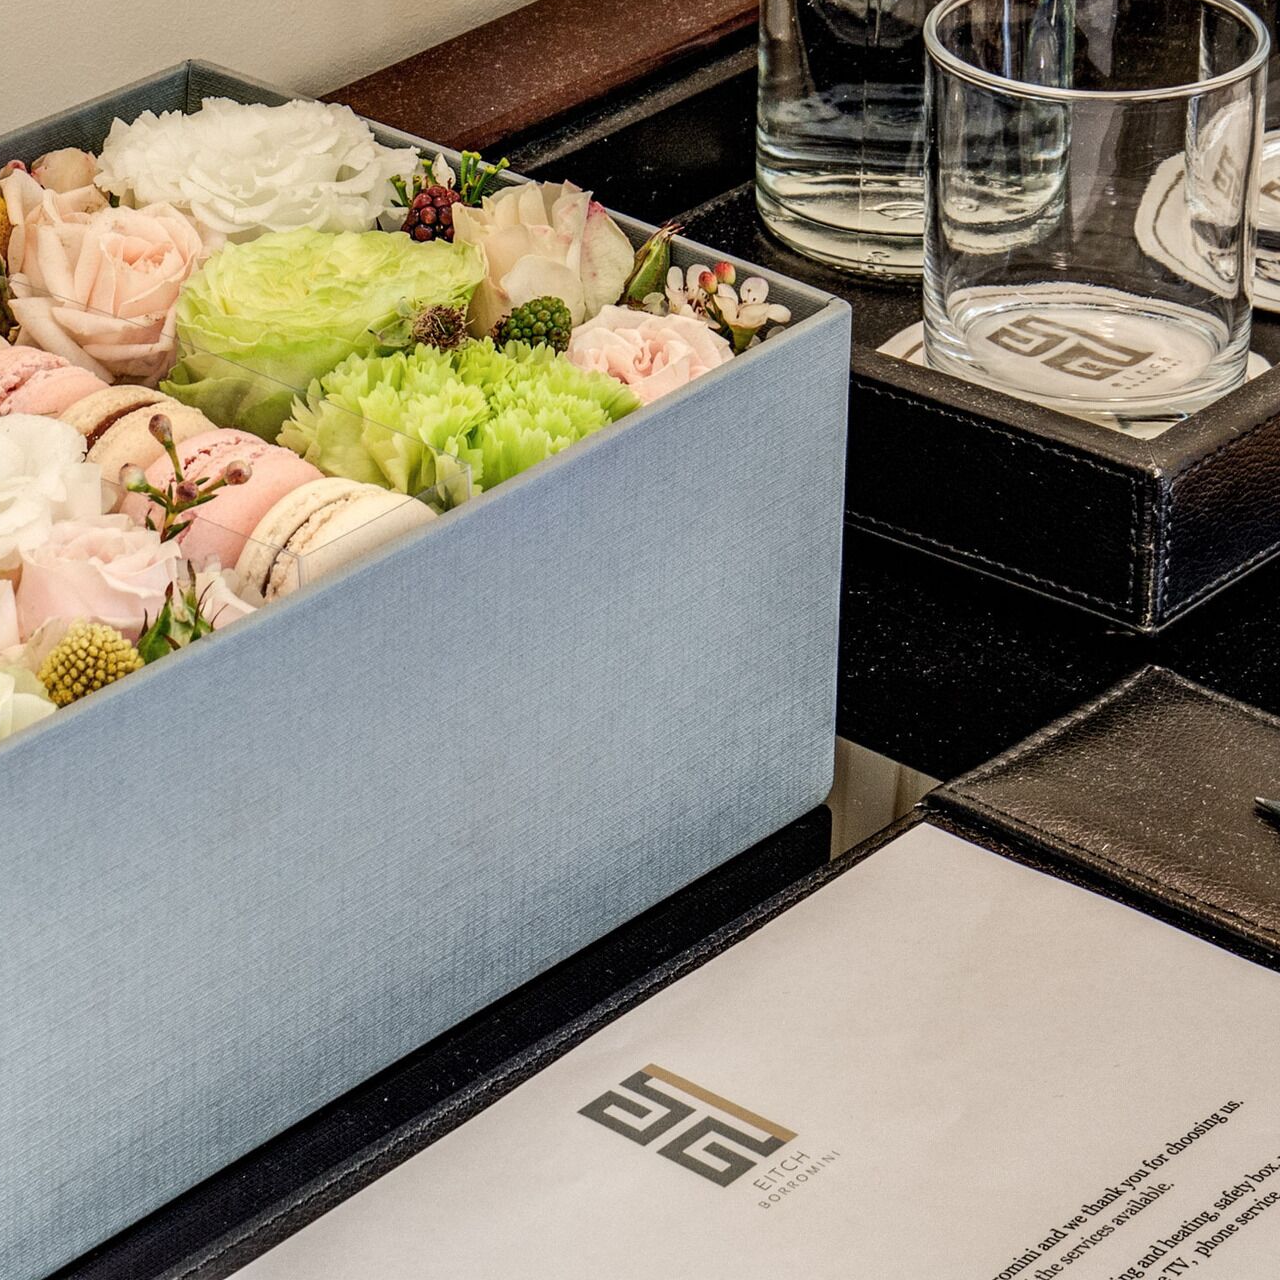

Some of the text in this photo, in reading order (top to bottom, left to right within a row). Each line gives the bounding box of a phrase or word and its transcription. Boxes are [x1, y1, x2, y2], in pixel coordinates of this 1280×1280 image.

[752, 1149, 812, 1192] EITCH
[757, 1149, 842, 1210] BORROMINI
[1037, 1228, 1069, 1251] and
[1062, 1215, 1088, 1230] we
[1080, 1186, 1127, 1216] thank
[1120, 1168, 1152, 1191] you
[1141, 1153, 1170, 1170] for
[1165, 1112, 1229, 1155] choosing
[1219, 1100, 1245, 1114] us.
[1060, 1224, 1116, 1265] services
[1111, 1182, 1176, 1226] available.
[1137, 1245, 1169, 1269] and
[1156, 1210, 1221, 1249] heating,
[1213, 1180, 1256, 1210] safety
[1194, 1223, 1239, 1258] phone
